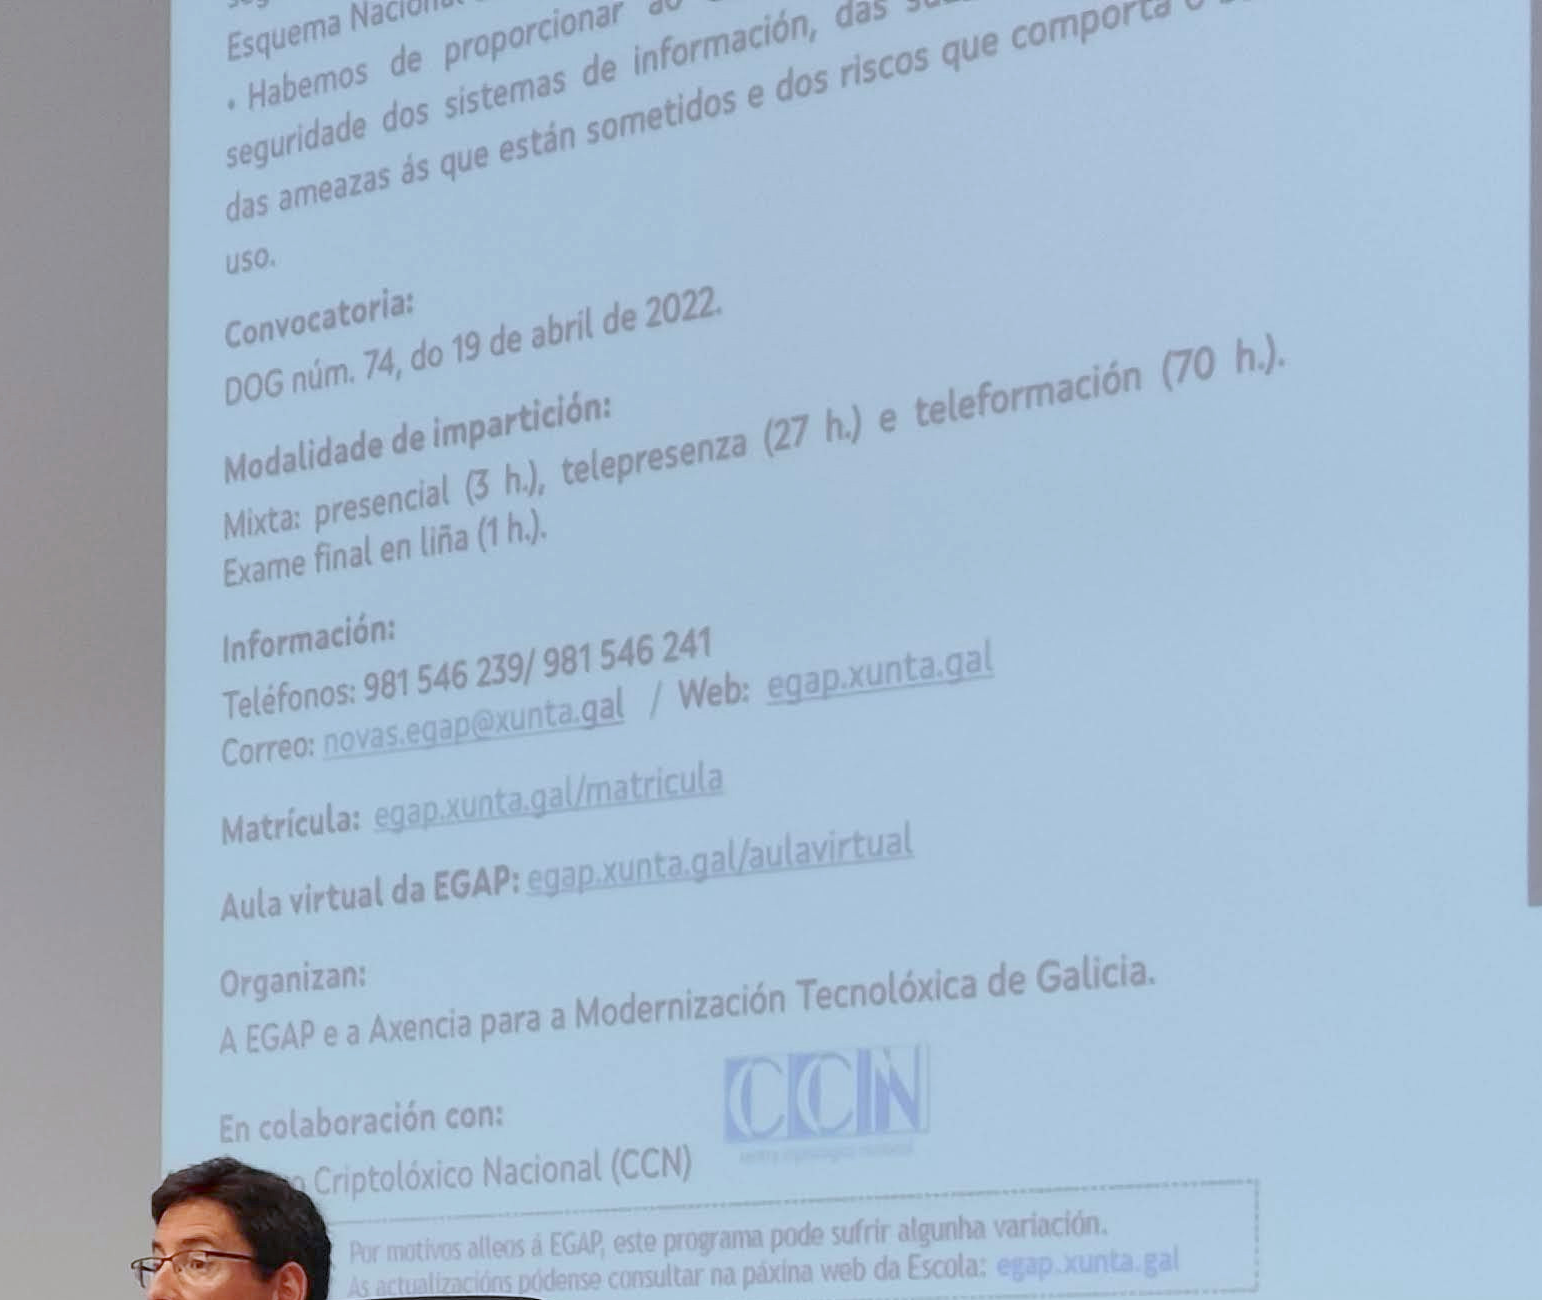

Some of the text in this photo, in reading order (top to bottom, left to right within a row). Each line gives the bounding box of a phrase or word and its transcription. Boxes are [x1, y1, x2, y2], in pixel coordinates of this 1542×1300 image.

[228, 15, 341, 62] Esquema
[249, 63, 368, 111] Habemos
[390, 43, 422, 77] de
[445, 1, 624, 71] proporcionar
[226, 0, 1171, 223] das ameazas ás que están sometidos e dos riscos que comporta
[227, 0, 888, 170] seguridade dos sistemas de información, das
[226, 247, 275, 275] uso.
[225, 288, 414, 349] Convocatoria:
[225, 285, 722, 406] DOG núm. 74, do 19 de abril de 2022.
[224, 334, 1285, 540] Mixta: presencial (3 h.), telepresenza (27 h.) e teleformación (70 h.).
[224, 391, 611, 484] Modalidade de impartición:
[224, 508, 547, 588] Exame final en liña (1 h.).
[222, 626, 711, 719] Teléfonos: 981 546 239/ 981 546 241
[223, 612, 395, 663] Información:
[221, 736, 315, 767] Correo:
[677, 671, 750, 710] Web:
[767, 639, 994, 706] egap.xunta.gal
[221, 802, 361, 846] Matrícula:
[220, 823, 914, 922] Aula virtual da EGAP: egap.xunta.gal/aulavirtual
[220, 961, 366, 1002] Organizan:
[220, 954, 1155, 1054] A EGAP e a Axencia para a Modernización Tecnolóxica de Galicia.
[220, 1100, 503, 1143] En colaboración con:
[724, 1047, 929, 1141] CCN
[315, 1160, 473, 1201] Criptolóxico
[483, 1148, 602, 1187] Nacional
[611, 1144, 692, 1186] (CCN)
[349, 1240, 381, 1264] Por
[550, 1229, 605, 1260] EGAP,
[613, 1230, 658, 1255] este
[663, 1228, 765, 1258] programa
[769, 1220, 825, 1254] pode
[831, 1218, 892, 1246] sufrir
[897, 1214, 987, 1250] algunha
[992, 1210, 1108, 1239] variación.
[607, 1262, 705, 1291] consultar
[710, 1266, 737, 1287] na
[820, 1256, 867, 1283] web
[873, 1254, 901, 1282] da
[907, 1252, 987, 1280] Escola:
[996, 1245, 1179, 1283] egap.xunta.gal
